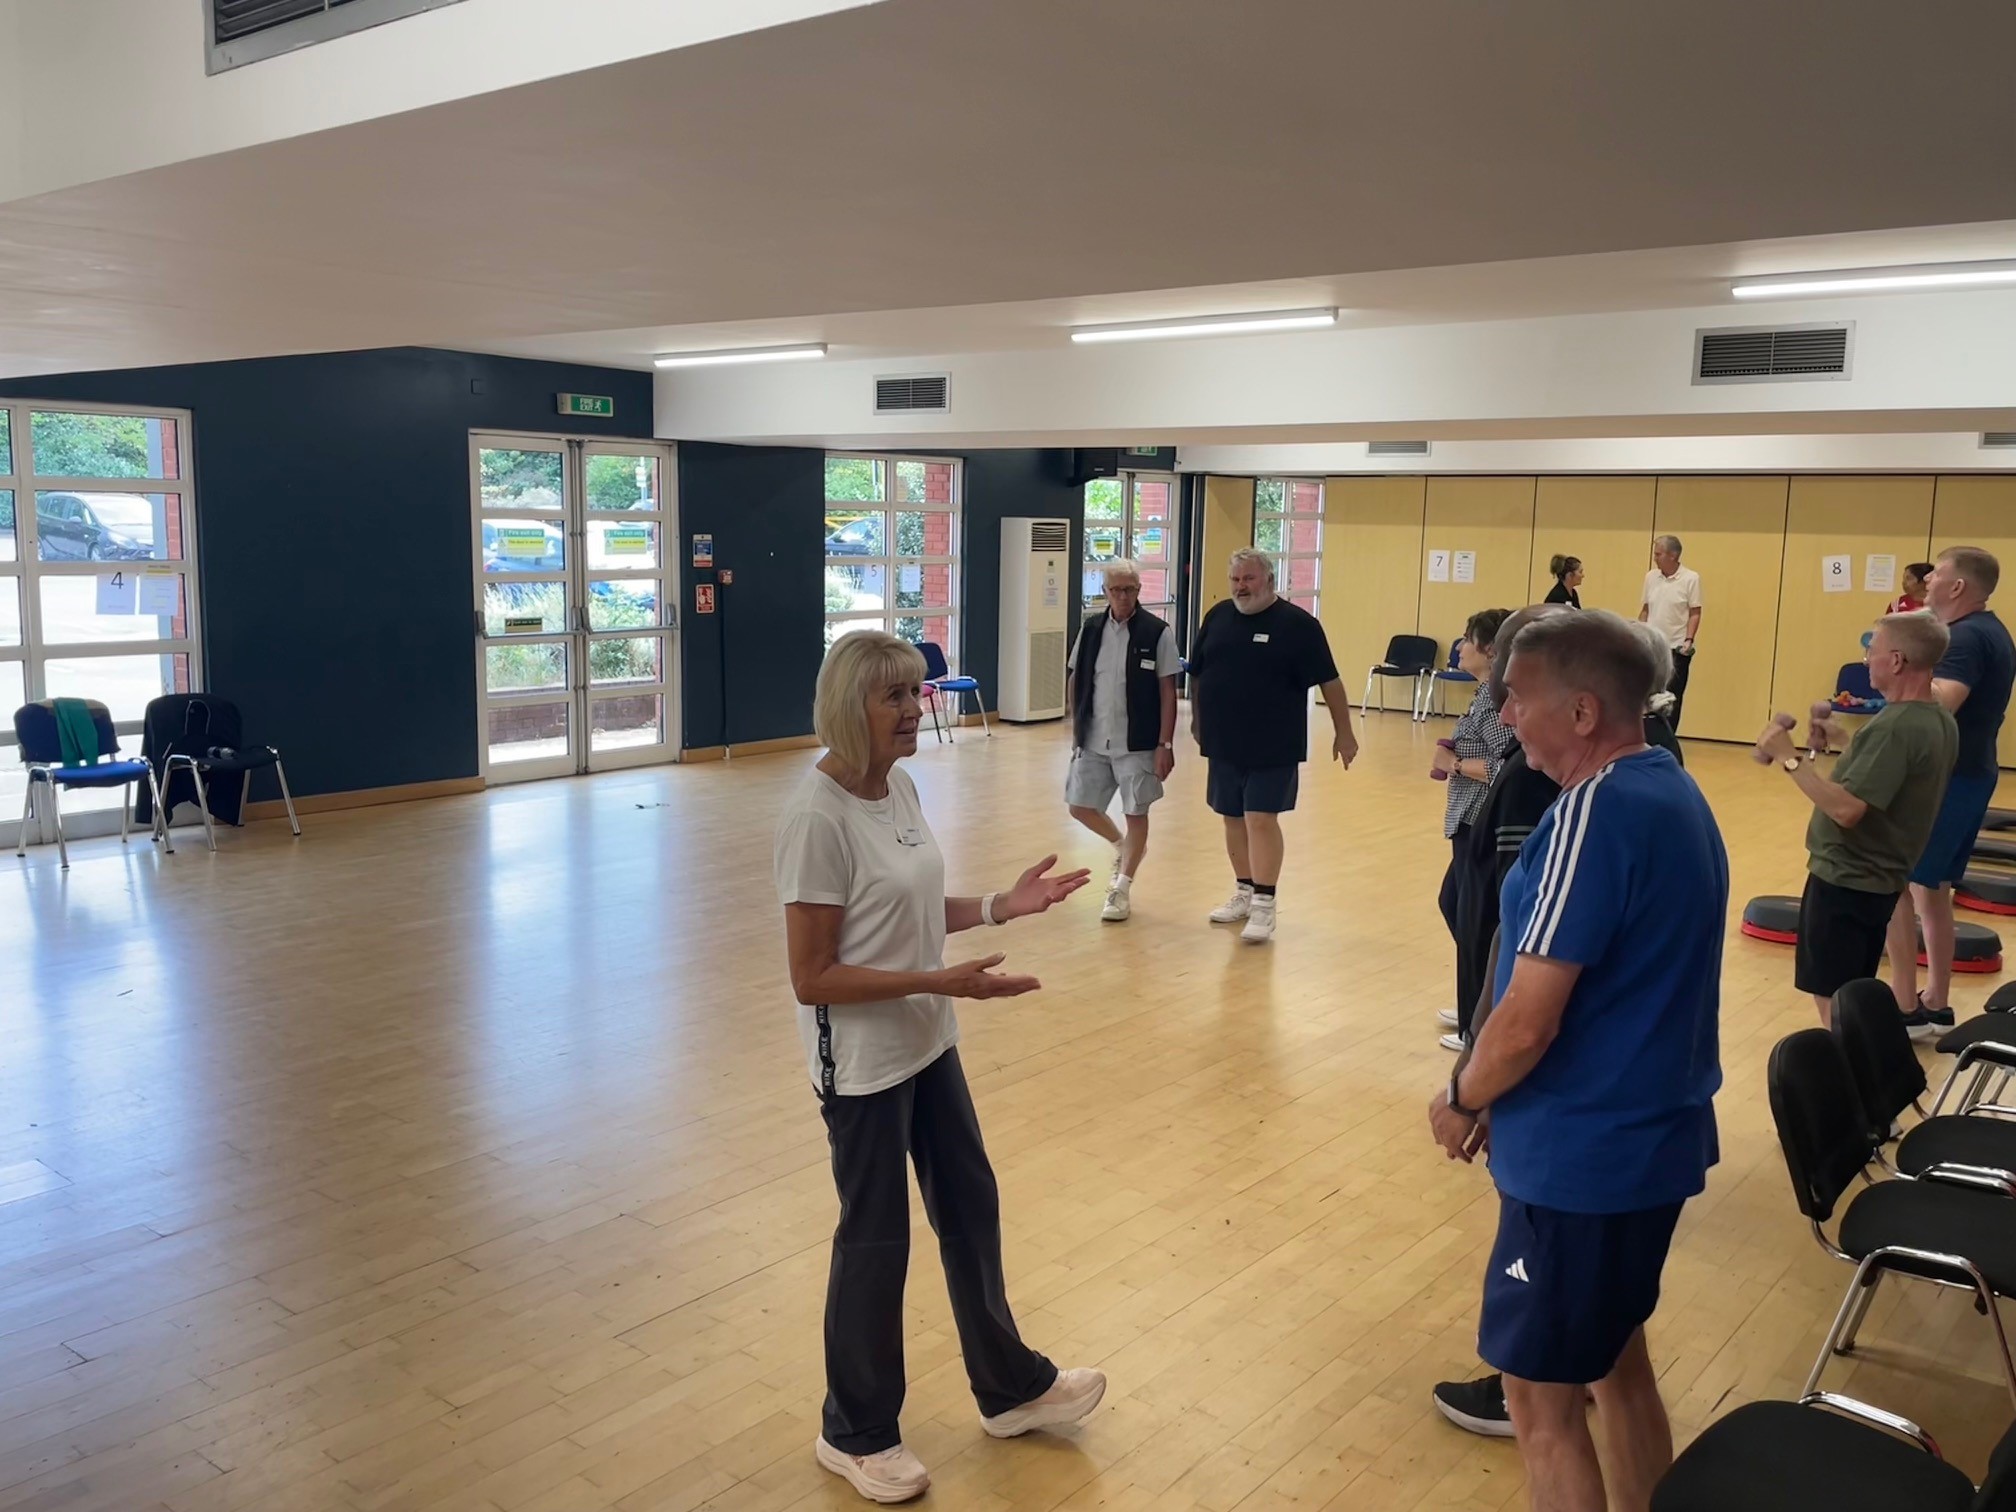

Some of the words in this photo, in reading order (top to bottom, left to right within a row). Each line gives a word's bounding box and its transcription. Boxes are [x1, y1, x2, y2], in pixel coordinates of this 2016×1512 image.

[1436, 555, 1443, 567] 7
[1832, 561, 1842, 575] 8
[871, 564, 877, 578] 5
[111, 572, 124, 589] 4
[824, 1067, 832, 1086] NIKE
